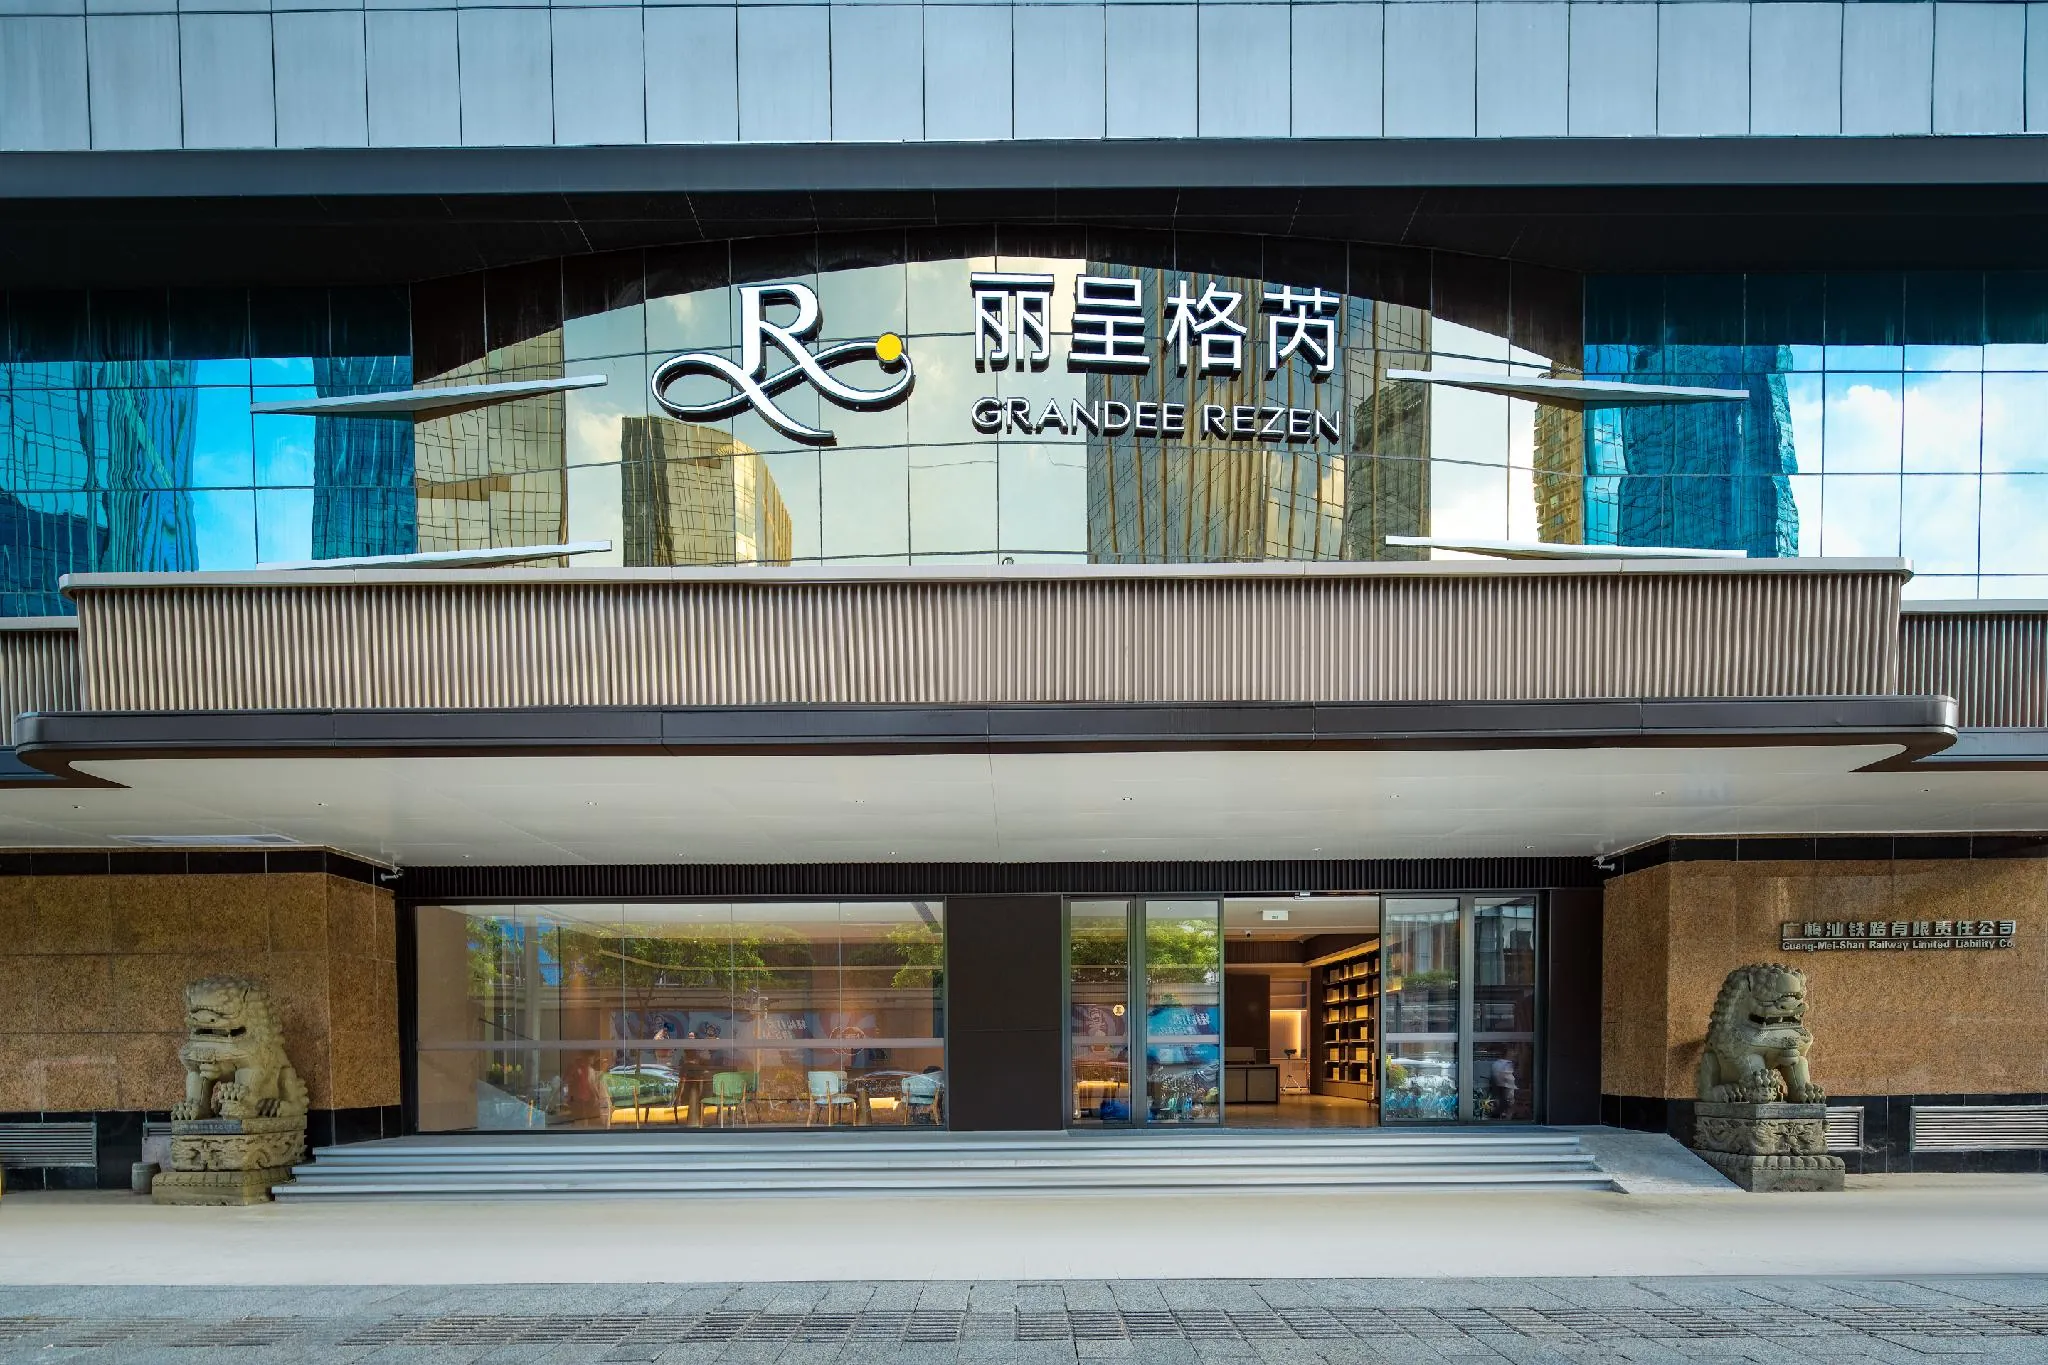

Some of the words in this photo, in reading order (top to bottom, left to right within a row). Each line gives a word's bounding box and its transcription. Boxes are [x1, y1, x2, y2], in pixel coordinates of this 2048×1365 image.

[971, 272, 1341, 383] 丽呈格芮
[971, 397, 1186, 438] GRANDEE
[1201, 403, 1341, 443] REZEN
[1782, 920, 2017, 937] 广梅汕铁路有限责任公司
[1782, 940, 1865, 952] Guang-Mei-Shan
[1868, 939, 1909, 951] Railway
[1912, 939, 1950, 949] Limited
[1955, 938, 1995, 949] Liability
[1999, 937, 2017, 949] Co.
